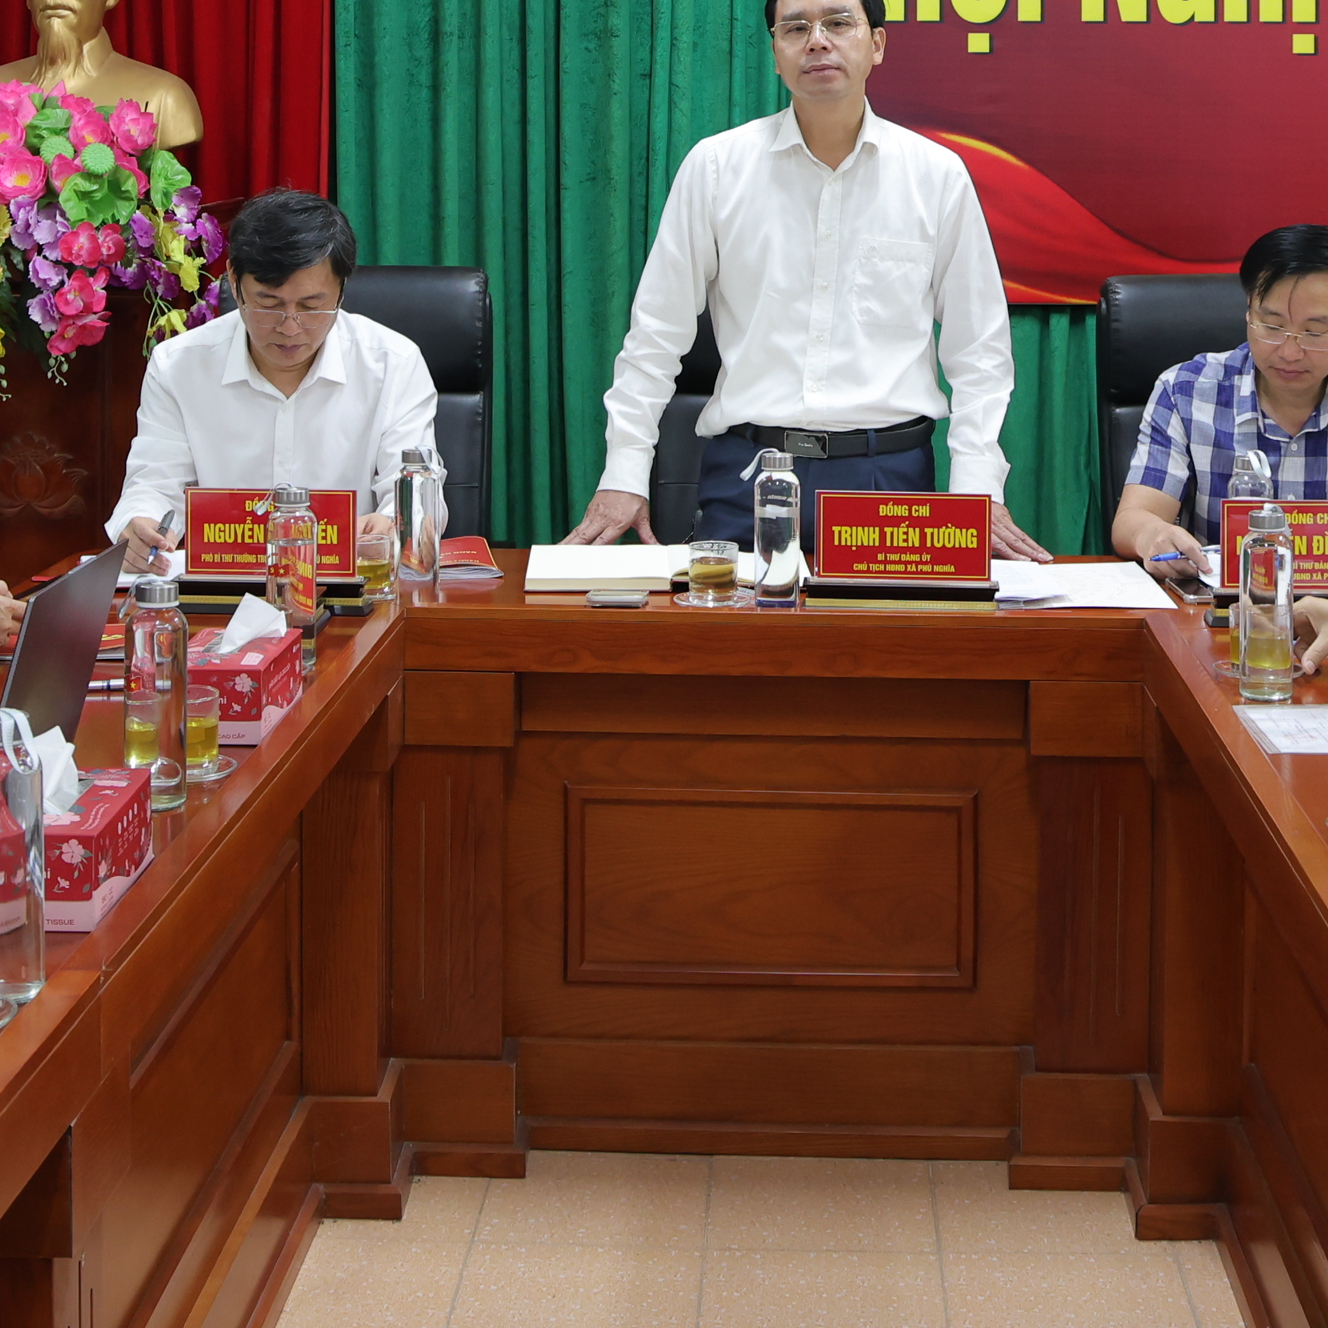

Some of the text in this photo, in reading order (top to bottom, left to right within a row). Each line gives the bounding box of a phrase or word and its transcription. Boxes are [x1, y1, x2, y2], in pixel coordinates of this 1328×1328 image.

[912, 503, 930, 517] CHÍ
[203, 516, 265, 544] NGUYỄN
[832, 521, 978, 551] TRỊNH TIẾN TƯỜNG
[877, 552, 885, 561] BÍ
[886, 553, 900, 562] THƯ
[901, 552, 921, 562] ĐẢNG
[869, 563, 885, 573] TỊCH
[1299, 561, 1313, 570] THƯ
[1312, 572, 1322, 580] XÃ
[45, 918, 75, 926] TISSUE
